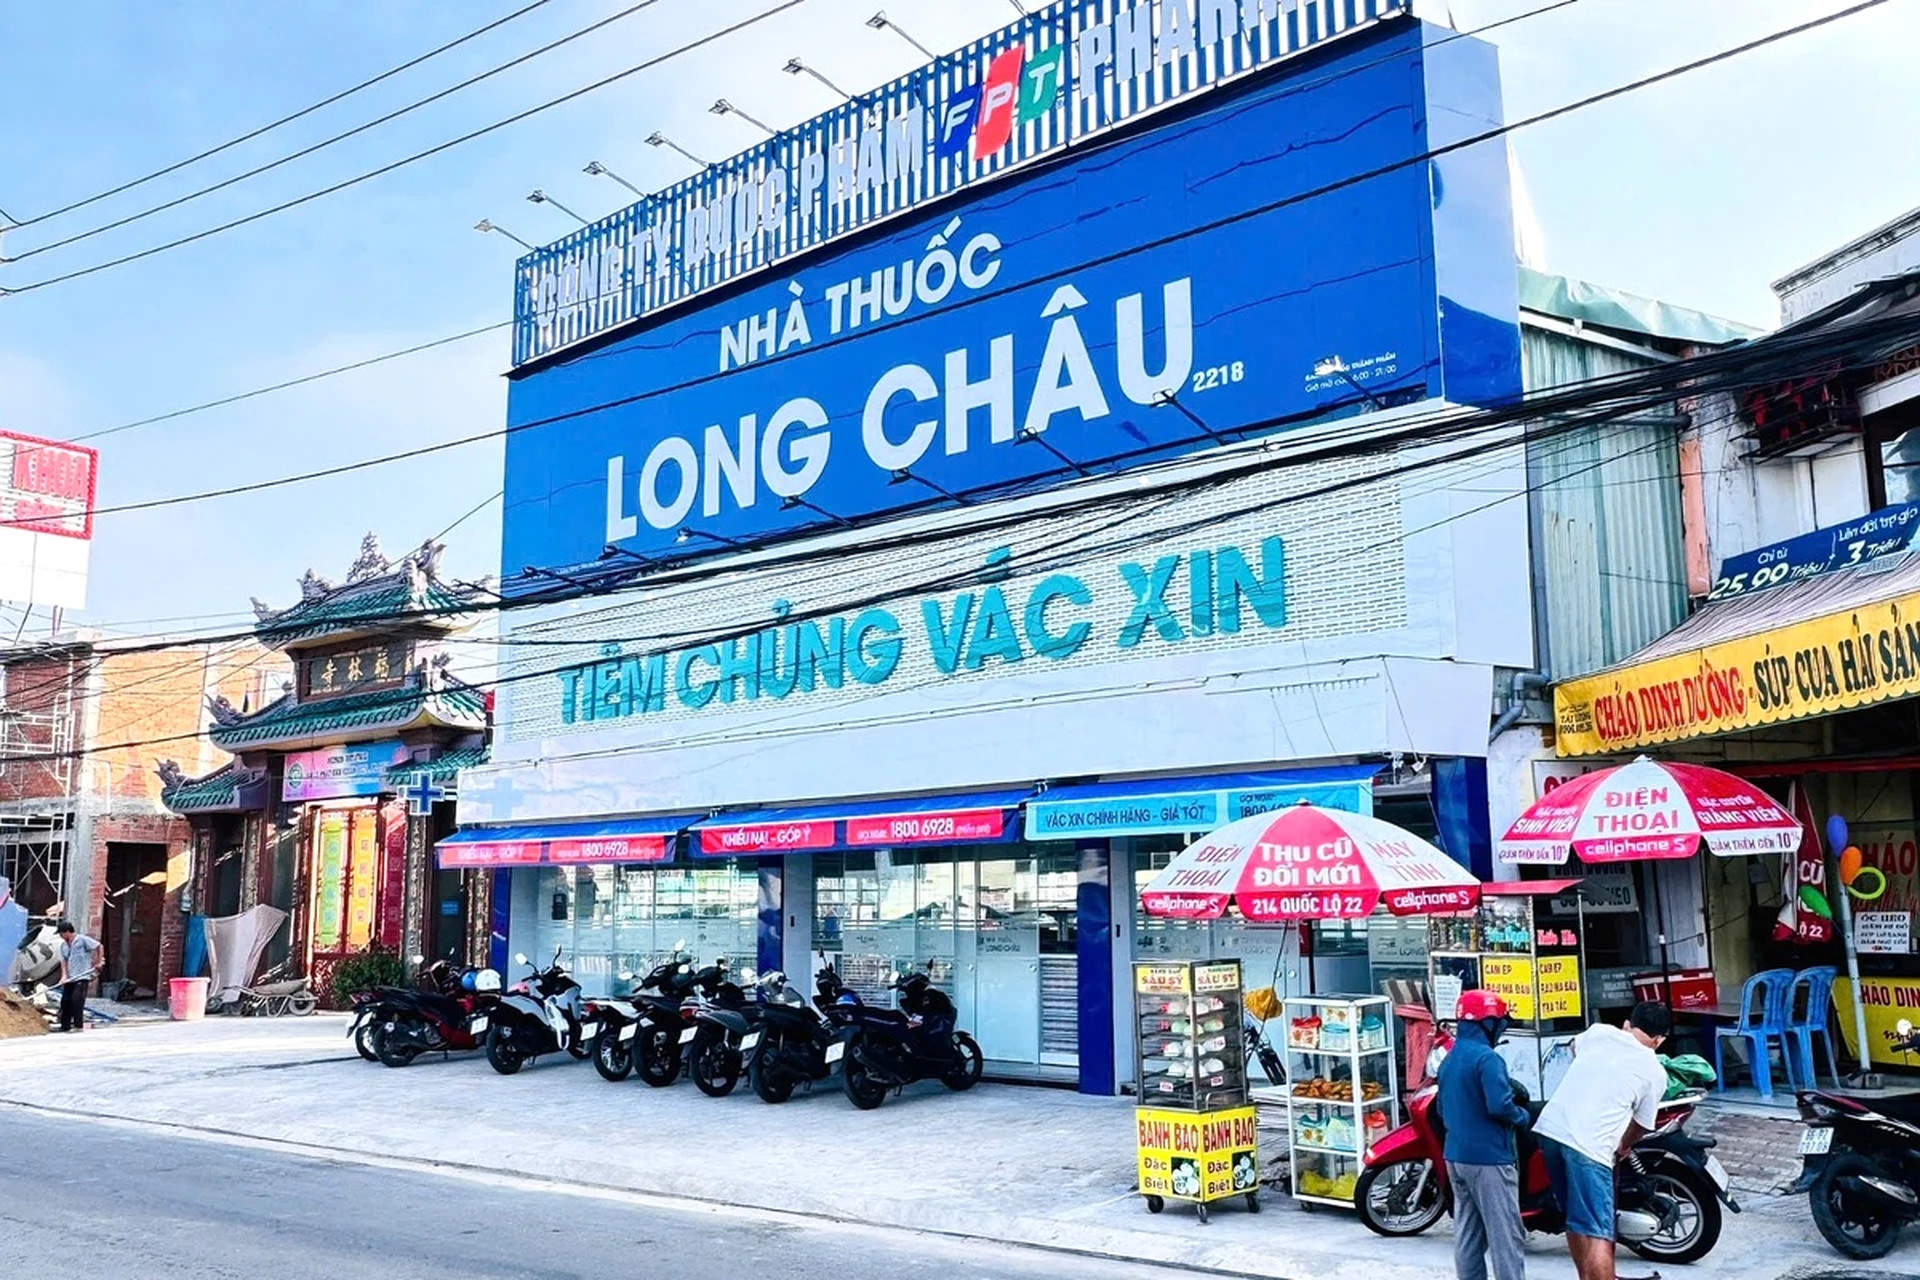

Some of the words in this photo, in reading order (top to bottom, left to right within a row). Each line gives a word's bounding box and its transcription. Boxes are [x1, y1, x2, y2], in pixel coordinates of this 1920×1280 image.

[941, 57, 1057, 146] FPT
[719, 280, 813, 373] NHÀ
[825, 215, 1002, 335] THUỐC
[606, 397, 831, 543] LONG
[861, 277, 1194, 472] CHÂU
[1192, 361, 1245, 393] 2218
[1840, 540, 1866, 568] 3
[557, 643, 666, 724] TIÊM
[675, 598, 903, 709] CHỦNG
[1117, 536, 1286, 647] XIN
[1594, 681, 1639, 741] CHÁO
[1638, 680, 1687, 733] DINH
[1754, 644, 1791, 710] SÚP
[1793, 645, 1840, 702] CUA
[1838, 614, 1877, 693] HẢI
[1604, 786, 1669, 811] ĐIỆN
[1068, 812, 1085, 826] XIN
[1086, 809, 1120, 825] CHÍNH
[1182, 800, 1206, 820] TỐT
[1512, 818, 1546, 833] SINH
[1546, 815, 1580, 833] VIÊN
[1593, 810, 1679, 834] THOẠI
[1742, 805, 1784, 822] VIÊN
[890, 821, 919, 838] 1800
[921, 818, 954, 836] 6928
[605, 841, 629, 857] 6928
[1257, 842, 1311, 863] THU
[1316, 836, 1353, 861] CŨ
[1253, 862, 1300, 887] ĐỔI
[1306, 863, 1361, 887] MỚI
[1253, 896, 1279, 914] 214
[1280, 892, 1319, 915] QUỐC
[1322, 894, 1342, 917] LỘ
[1344, 895, 1363, 912] 22
[1809, 925, 1823, 938] 22
